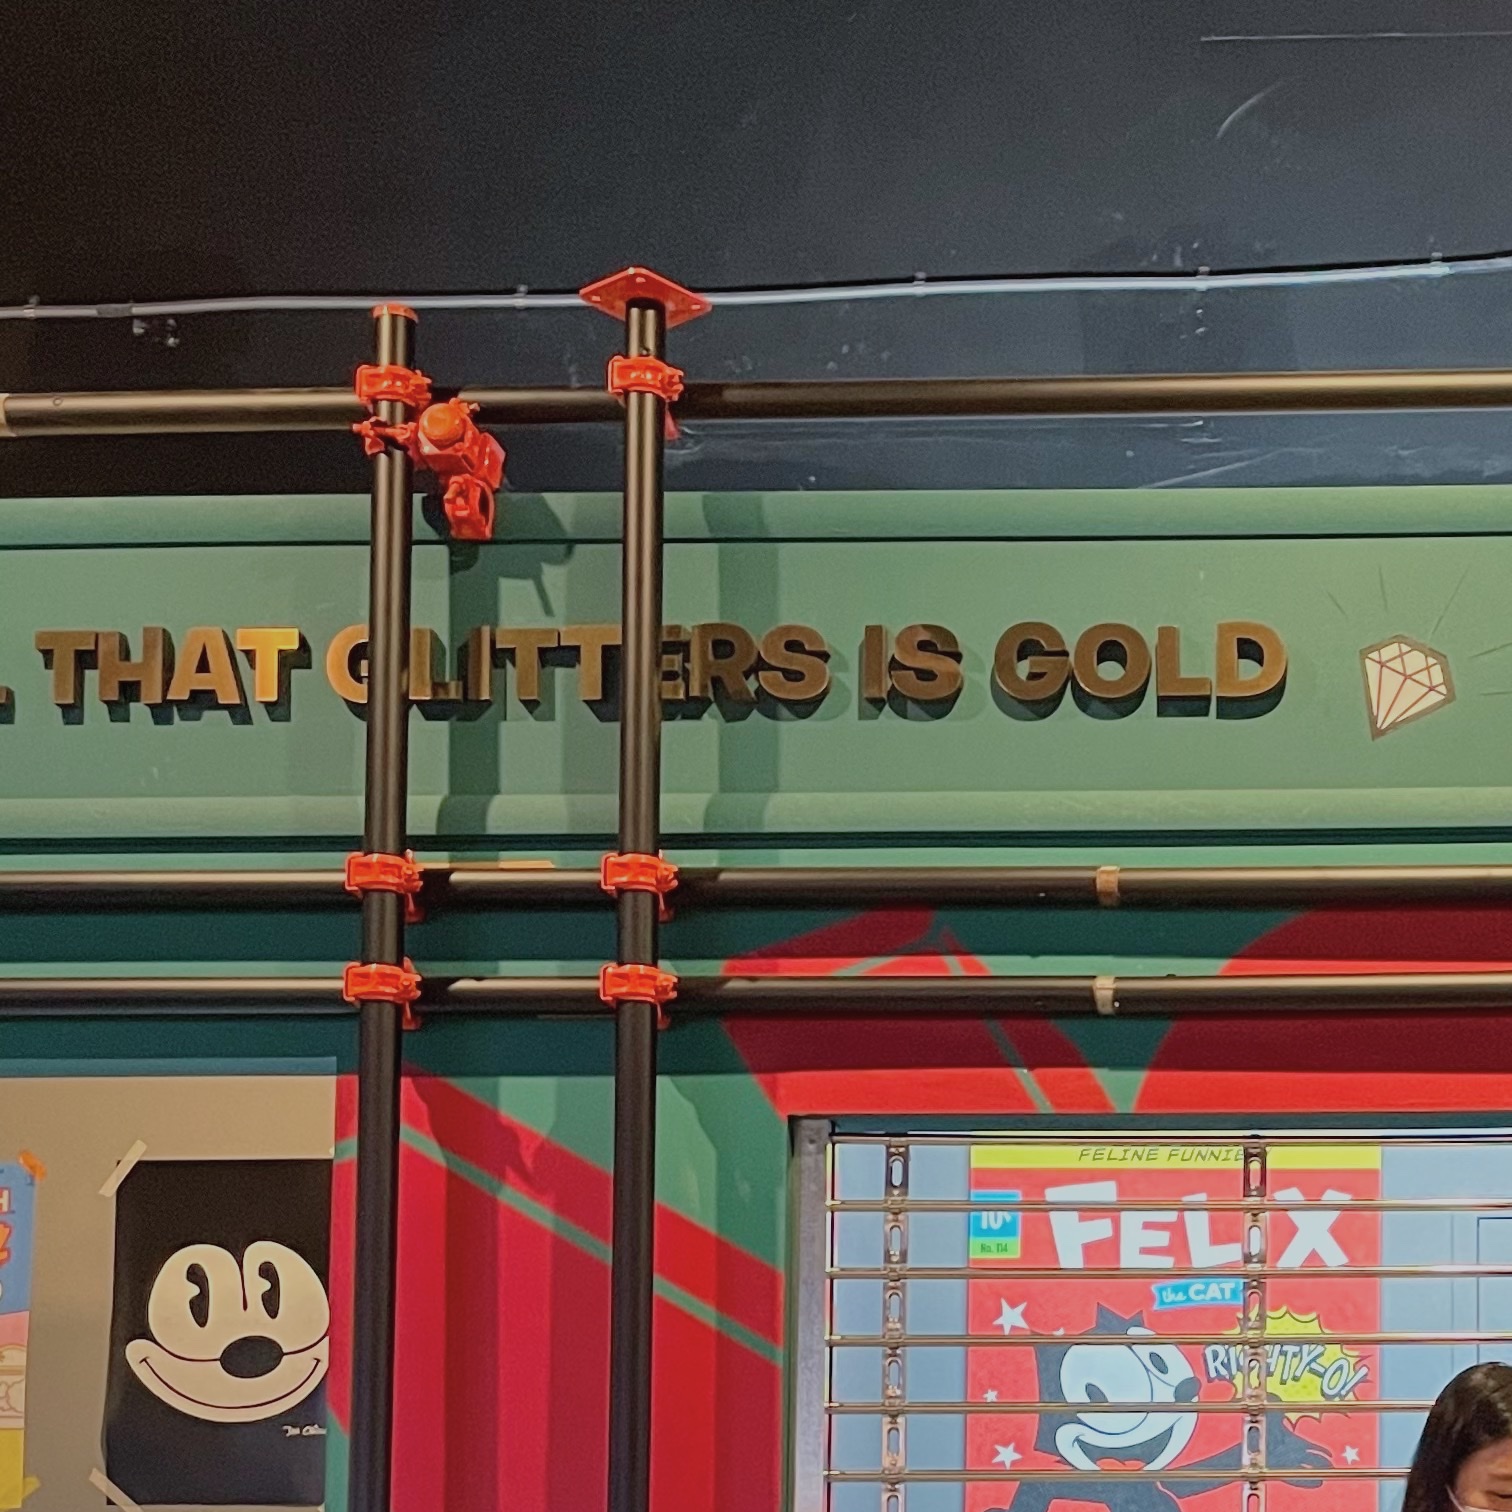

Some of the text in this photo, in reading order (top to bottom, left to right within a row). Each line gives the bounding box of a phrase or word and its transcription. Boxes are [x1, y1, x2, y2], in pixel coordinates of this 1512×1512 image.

[34, 624, 312, 714] THAT
[325, 622, 832, 712] GLITTERS
[858, 622, 965, 712] IS
[993, 620, 1289, 712] GOLD
[1078, 1147, 1245, 1162] FELINE FUNNIE
[1045, 1180, 1354, 1268] FELX
[1187, 1282, 1236, 1301] CAT
